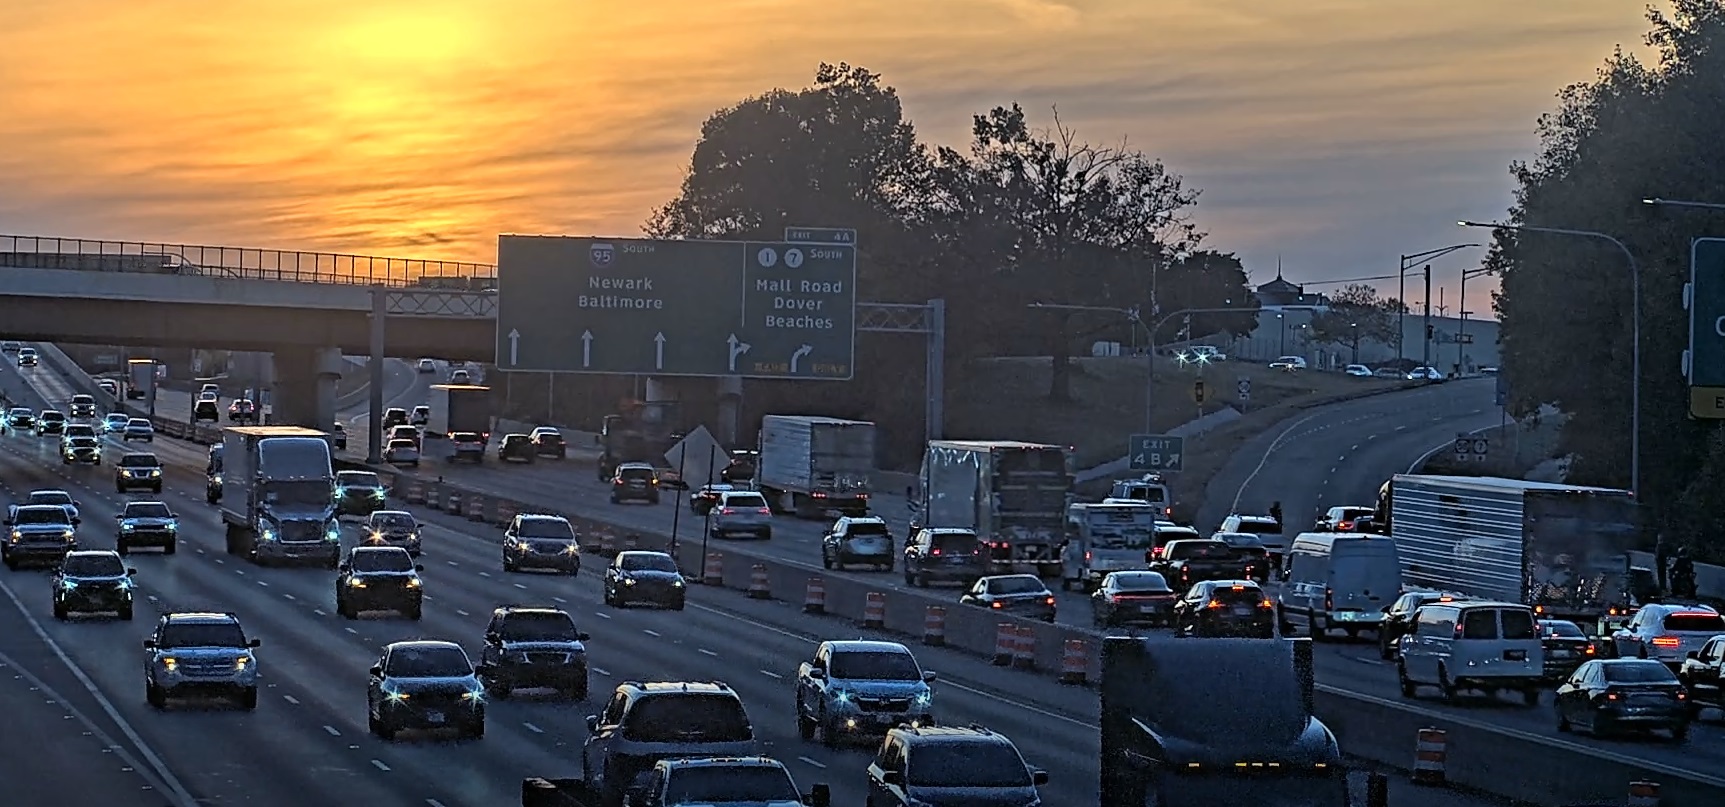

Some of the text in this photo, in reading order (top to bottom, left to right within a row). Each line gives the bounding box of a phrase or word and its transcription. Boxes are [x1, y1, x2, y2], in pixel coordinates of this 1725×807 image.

[834, 232, 850, 241] 4A
[593, 250, 611, 262] 95
[589, 276, 653, 290] Newark
[756, 279, 842, 293] Mall Road
[578, 295, 663, 309] Baltimore
[774, 296, 823, 310] Dover
[765, 315, 833, 329] Beaches
[1143, 439, 1171, 449] EXIT
